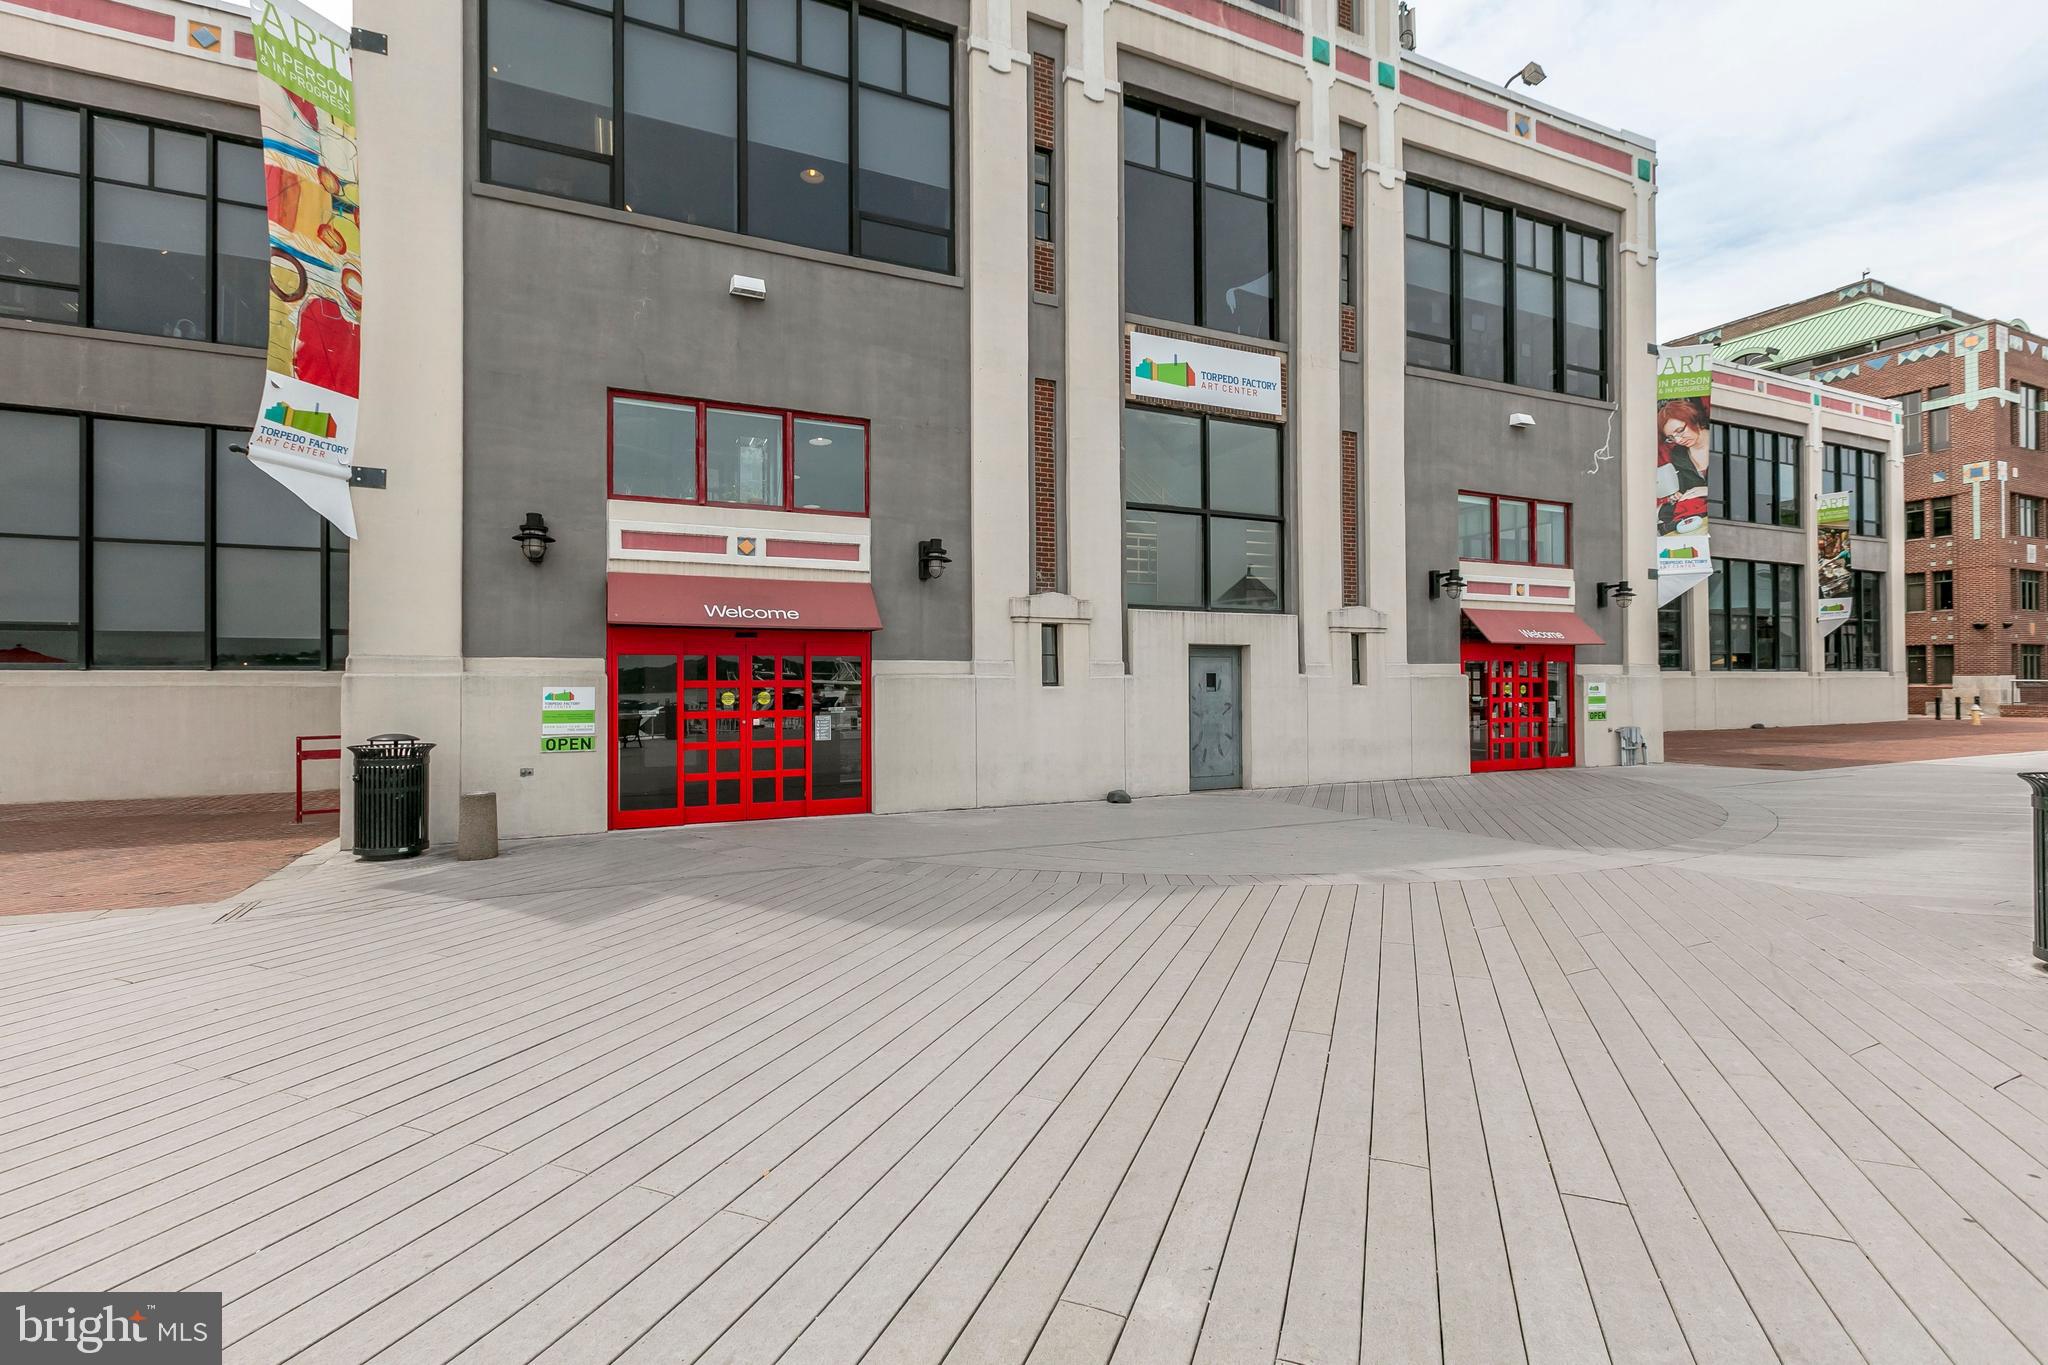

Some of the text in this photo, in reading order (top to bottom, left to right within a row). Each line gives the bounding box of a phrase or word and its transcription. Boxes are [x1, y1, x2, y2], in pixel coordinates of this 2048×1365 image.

[260, 0, 346, 69] ART
[258, 37, 350, 102] IN PERSON
[260, 54, 351, 114] & IN PROGRESS
[1662, 353, 1710, 374] ART
[1201, 371, 1277, 391] TORPEDO FACTORY
[1201, 382, 1258, 396] ART CENTER
[1658, 376, 1710, 388] IN PERSON
[256, 436, 326, 458] ART CENTER
[260, 426, 349, 455] TORPEDO FACTORY
[1820, 496, 1847, 509] ART
[704, 604, 800, 620] Welcome
[1518, 629, 1565, 639] Welcome
[1589, 711, 1606, 720] OPEN
[545, 737, 592, 751] OPEN
